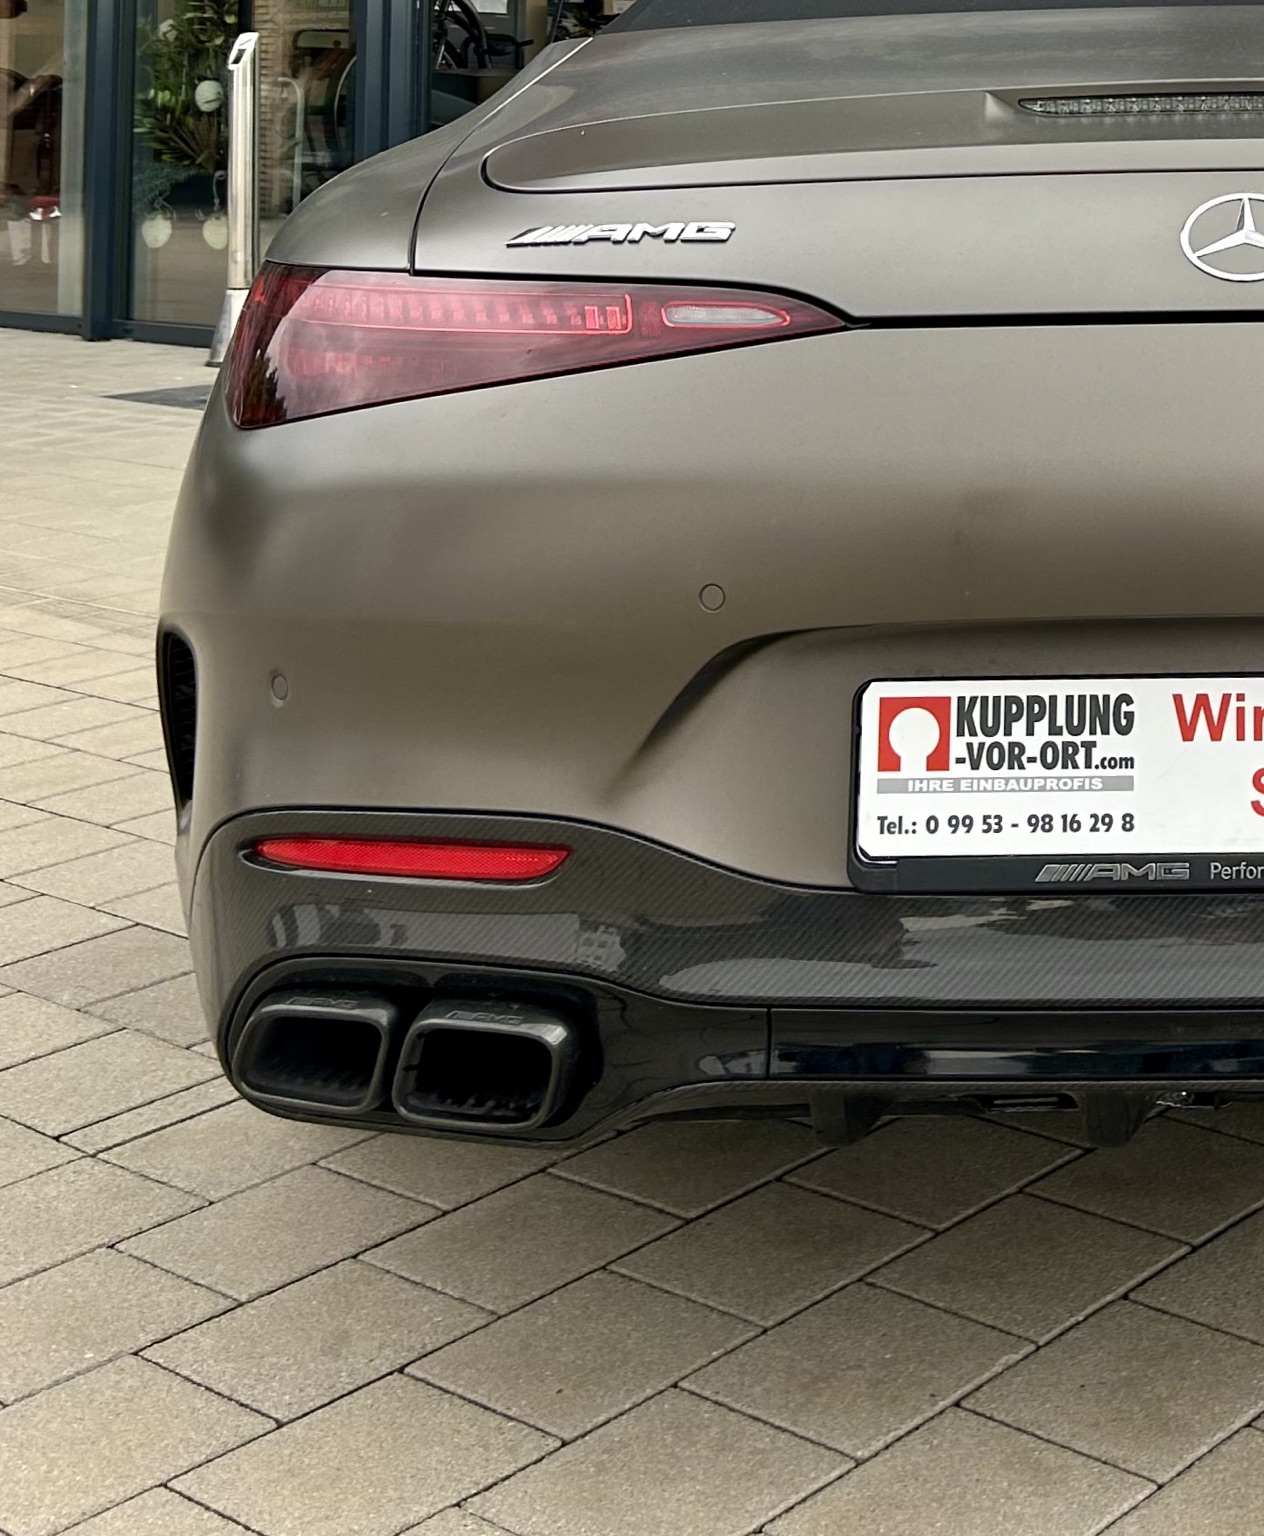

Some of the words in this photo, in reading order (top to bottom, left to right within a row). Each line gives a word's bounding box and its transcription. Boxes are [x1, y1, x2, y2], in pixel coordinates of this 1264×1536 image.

[571, 221, 736, 245] AMG
[955, 693, 1135, 737] KUPPLUNG
[955, 740, 1135, 771] -VOR-ORT.com
[907, 779, 954, 792] IHRE
[960, 777, 1104, 792] EINBAUPROFIS
[877, 815, 917, 835] Tel.:
[925, 815, 940, 834] 0
[947, 814, 974, 834] 99
[981, 814, 1004, 833] 53
[1027, 814, 1054, 833] 98
[1061, 813, 1082, 833] 16
[1089, 813, 1114, 832] 29
[1121, 813, 1135, 832] 8
[1085, 862, 1190, 881] AMG
